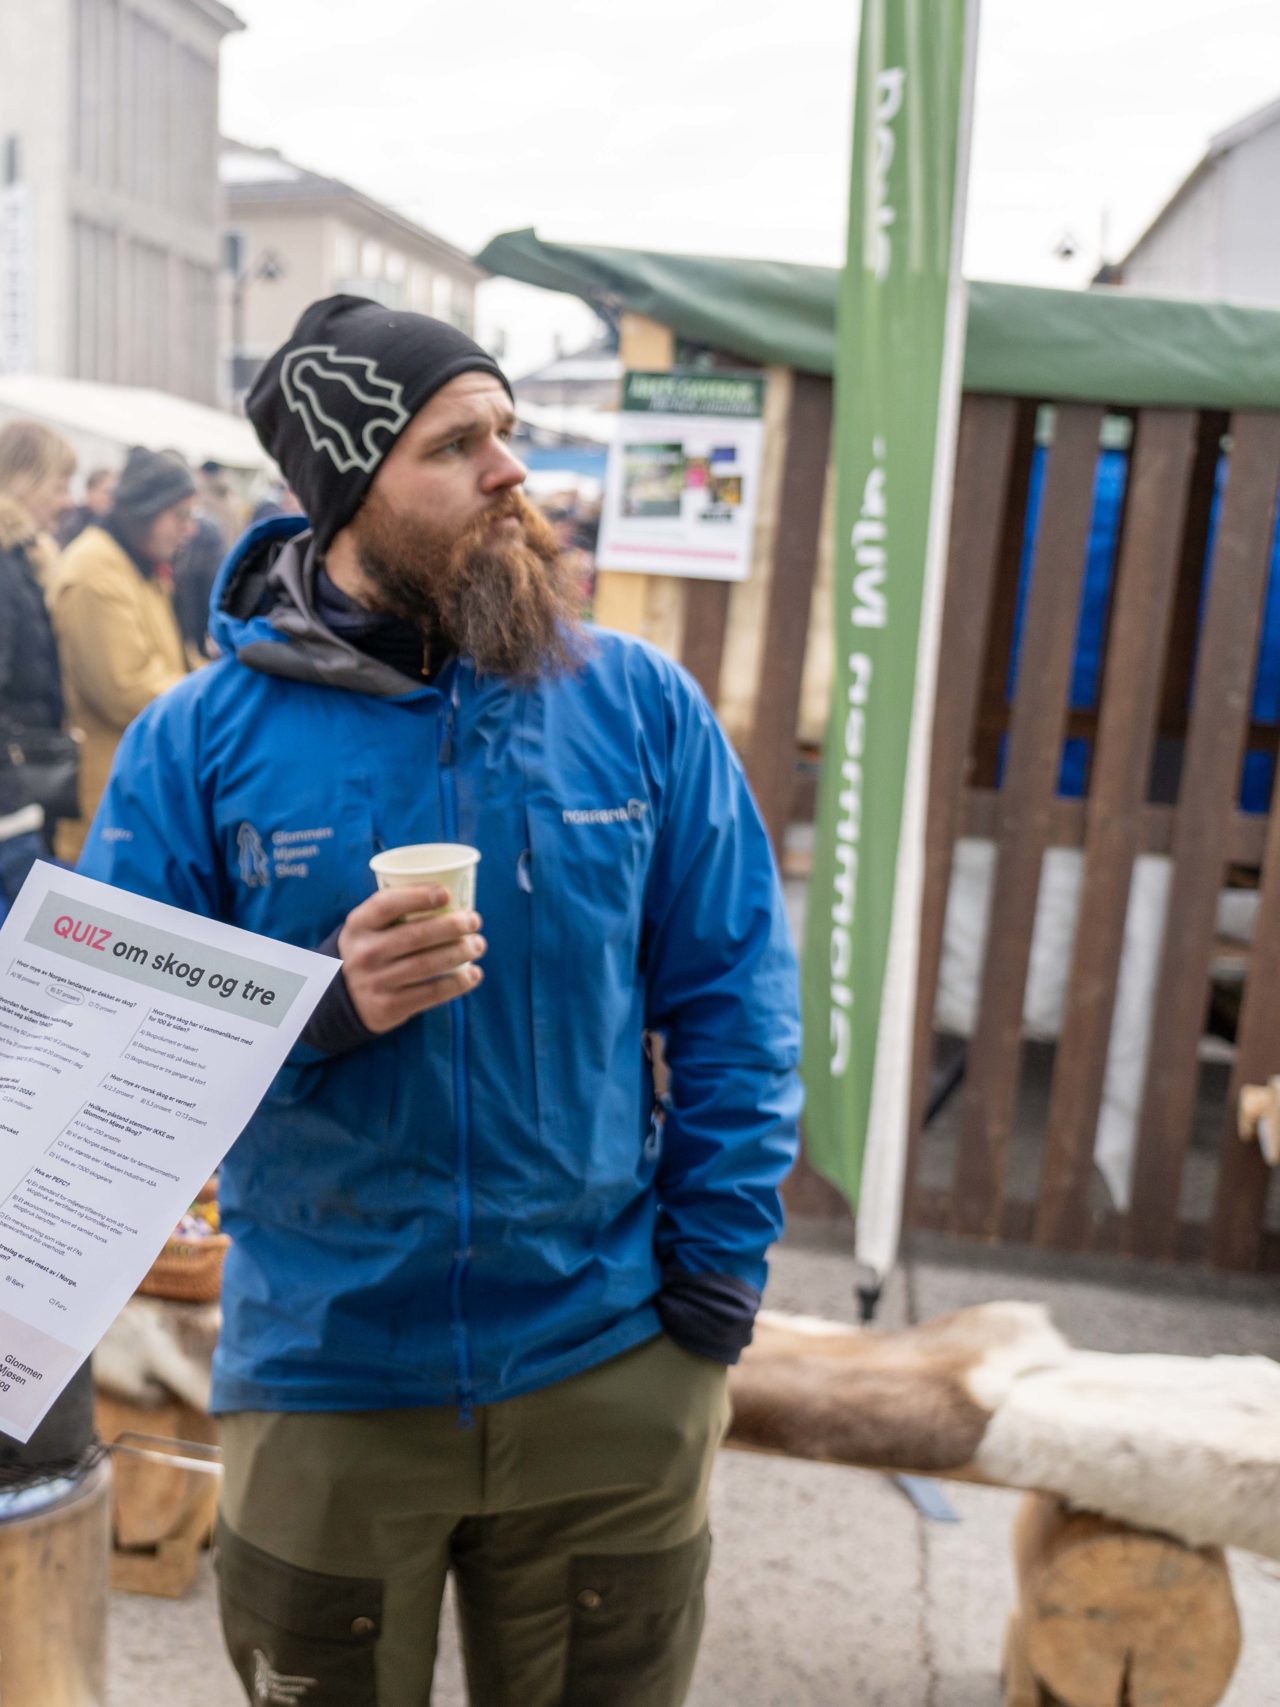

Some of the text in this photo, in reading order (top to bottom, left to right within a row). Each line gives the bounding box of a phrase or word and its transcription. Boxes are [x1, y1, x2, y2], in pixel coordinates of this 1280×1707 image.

[272, 827, 334, 846] Glommen
[273, 845, 319, 862] Mjøsen
[275, 863, 308, 879] Skog
[54, 916, 275, 1005] QUIZ om skog og tre
[16, 960, 29, 968] Hvor
[48, 972, 67, 983] Norges
[98, 991, 115, 1000] dekket
[121, 1000, 137, 1008] skog?
[20, 1004, 29, 1012] har
[24, 1016, 38, 1024] siden
[152, 1008, 165, 1016] Hvor
[176, 1017, 189, 1025] skog
[204, 1027, 240, 1041] sammenliknet
[173, 1024, 190, 1032] siden?
[110, 1074, 123, 1082] Hvor
[141, 1086, 156, 1094] norsk
[156, 1092, 169, 1100] skog
[176, 1099, 196, 1108] vernet?
[83, 1109, 142, 1136] Glommen Mjøse Skog?
[88, 1103, 107, 1114] Hvilken
[107, 1112, 129, 1123] påstand
[129, 1120, 152, 1131] stemmer
[153, 1129, 166, 1137] IKKE
[83, 1137, 100, 1148] Norges
[100, 1146, 117, 1155] største
[34, 1168, 45, 1176] Hva
[52, 1176, 70, 1186] PEFC?
[103, 1162, 123, 1173] Moelven
[124, 1170, 146, 1182] Industrier
[26, 1187, 48, 1200] skogbruk
[38, 1185, 60, 1197] standard
[106, 1217, 117, 1225] som
[60, 1218, 71, 1226] som
[44, 1235, 55, 1243] som
[0, 1244, 18, 1257] treslag
[25, 1257, 35, 1265] det
[35, 1262, 49, 1272] mest
[11, 1279, 24, 1288] Bjørk
[55, 1301, 67, 1310] Furu
[5, 1355, 42, 1379] Glommen
